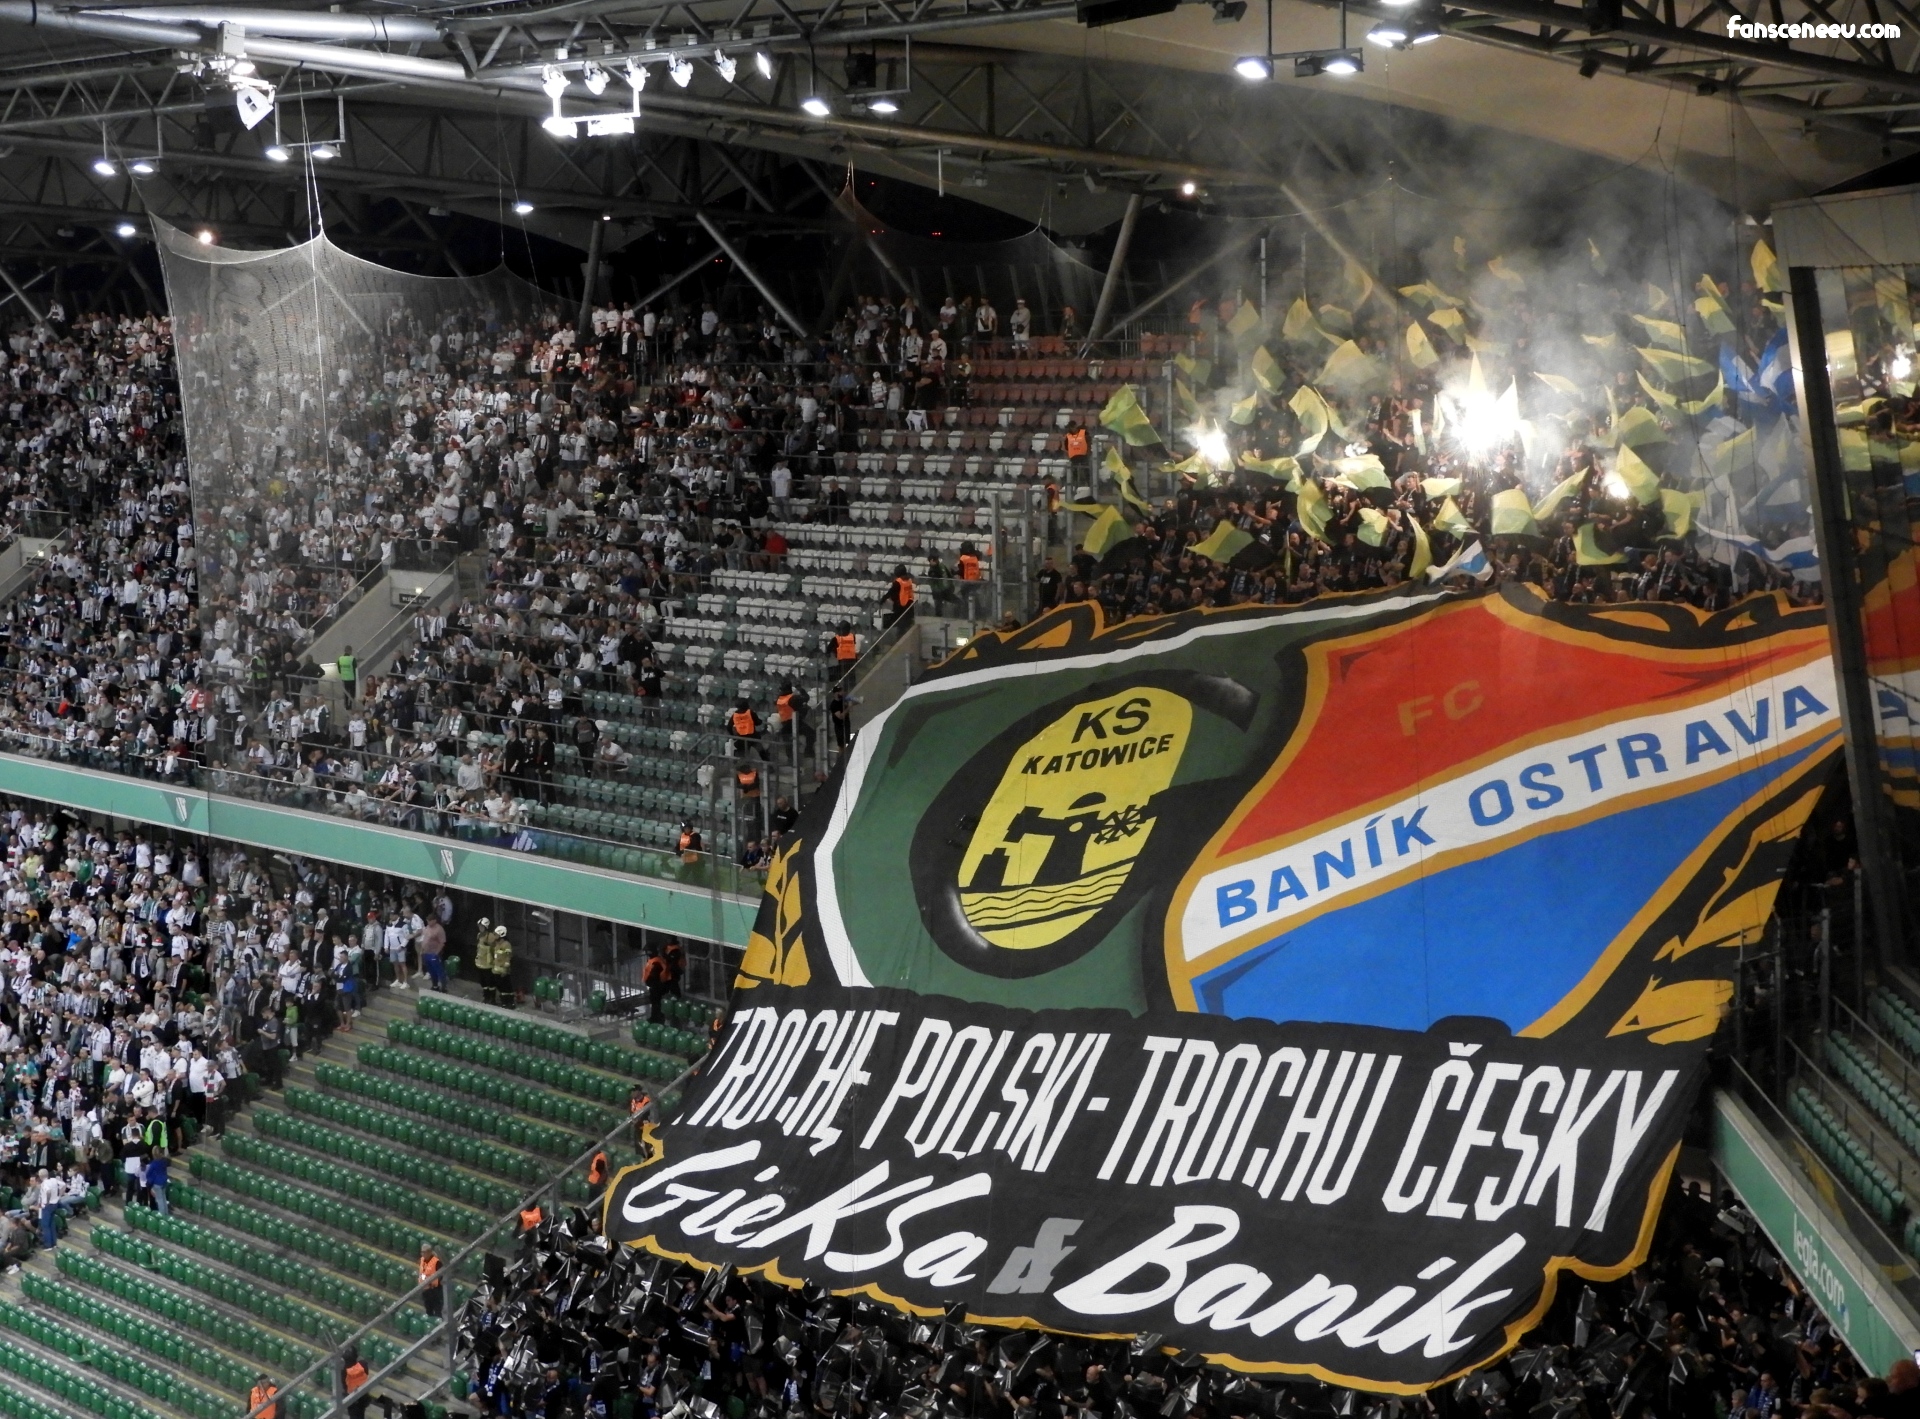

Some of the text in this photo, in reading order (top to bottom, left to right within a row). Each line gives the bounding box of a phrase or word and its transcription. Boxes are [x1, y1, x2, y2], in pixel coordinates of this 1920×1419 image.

[1022, 733, 1174, 775] KATOWICE
[1072, 697, 1151, 743] KS
[1400, 682, 1485, 735] FC
[1217, 686, 1829, 927] BANÍK OSTRAVA
[671, 1006, 901, 1157] TROCHĘ
[1097, 1033, 1403, 1204] TROCHU
[1382, 1041, 1680, 1232] ČESKY
[622, 1140, 1527, 1358] GieKSa & Baník
[1792, 1211, 1846, 1312] legia.com
